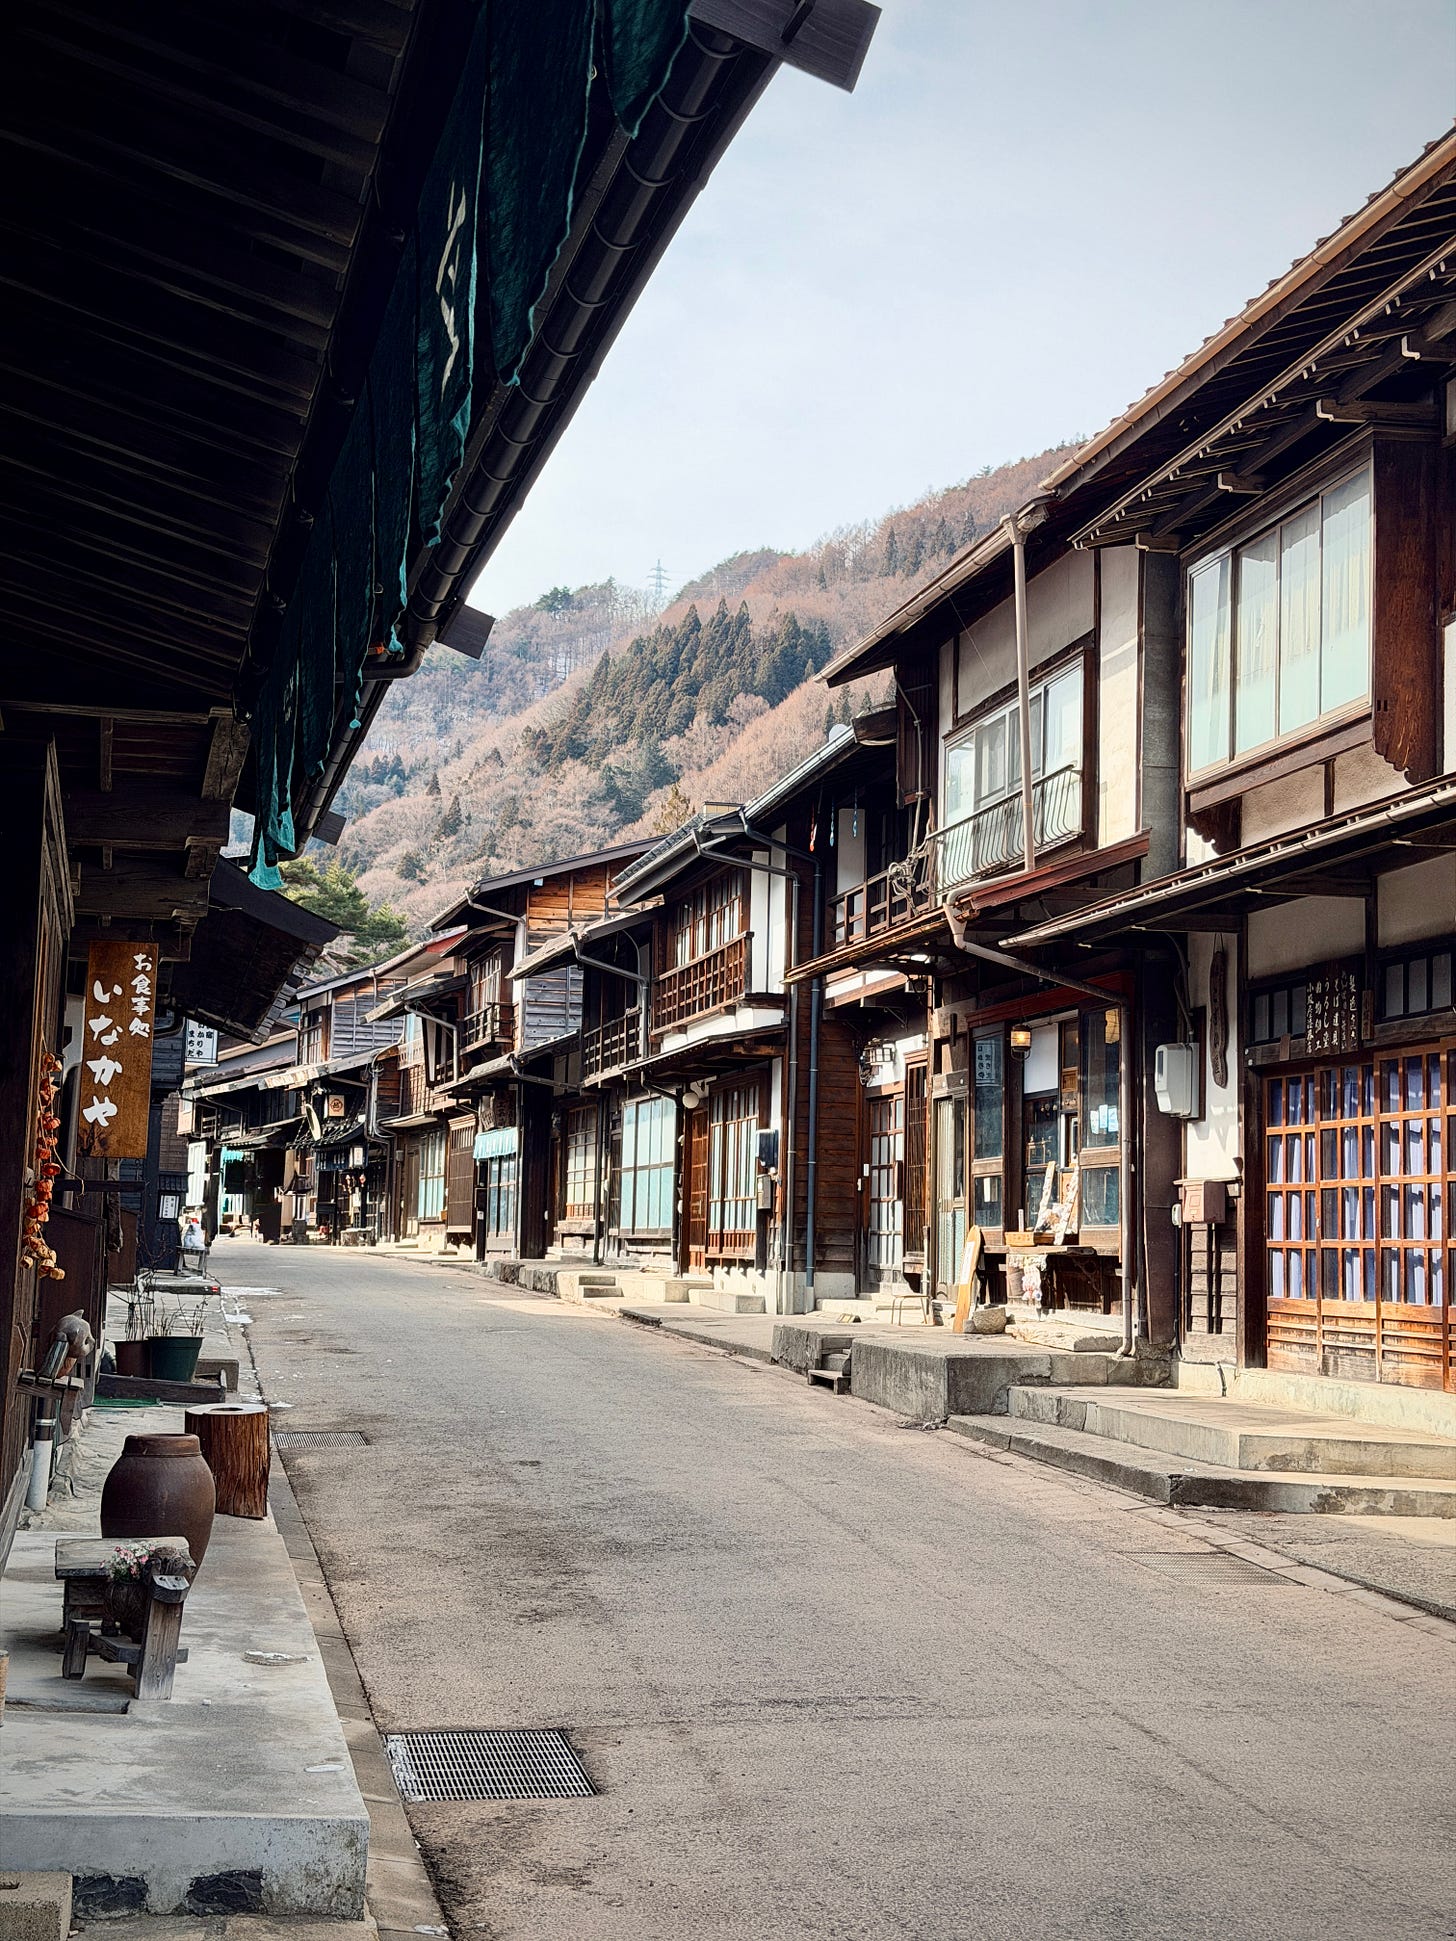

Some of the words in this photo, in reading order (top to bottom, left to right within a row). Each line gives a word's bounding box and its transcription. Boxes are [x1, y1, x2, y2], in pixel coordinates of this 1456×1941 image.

[129, 953, 153, 1038] お食事処
[83, 980, 123, 1127] いなかや
[187, 1030, 195, 1057] まちだ
